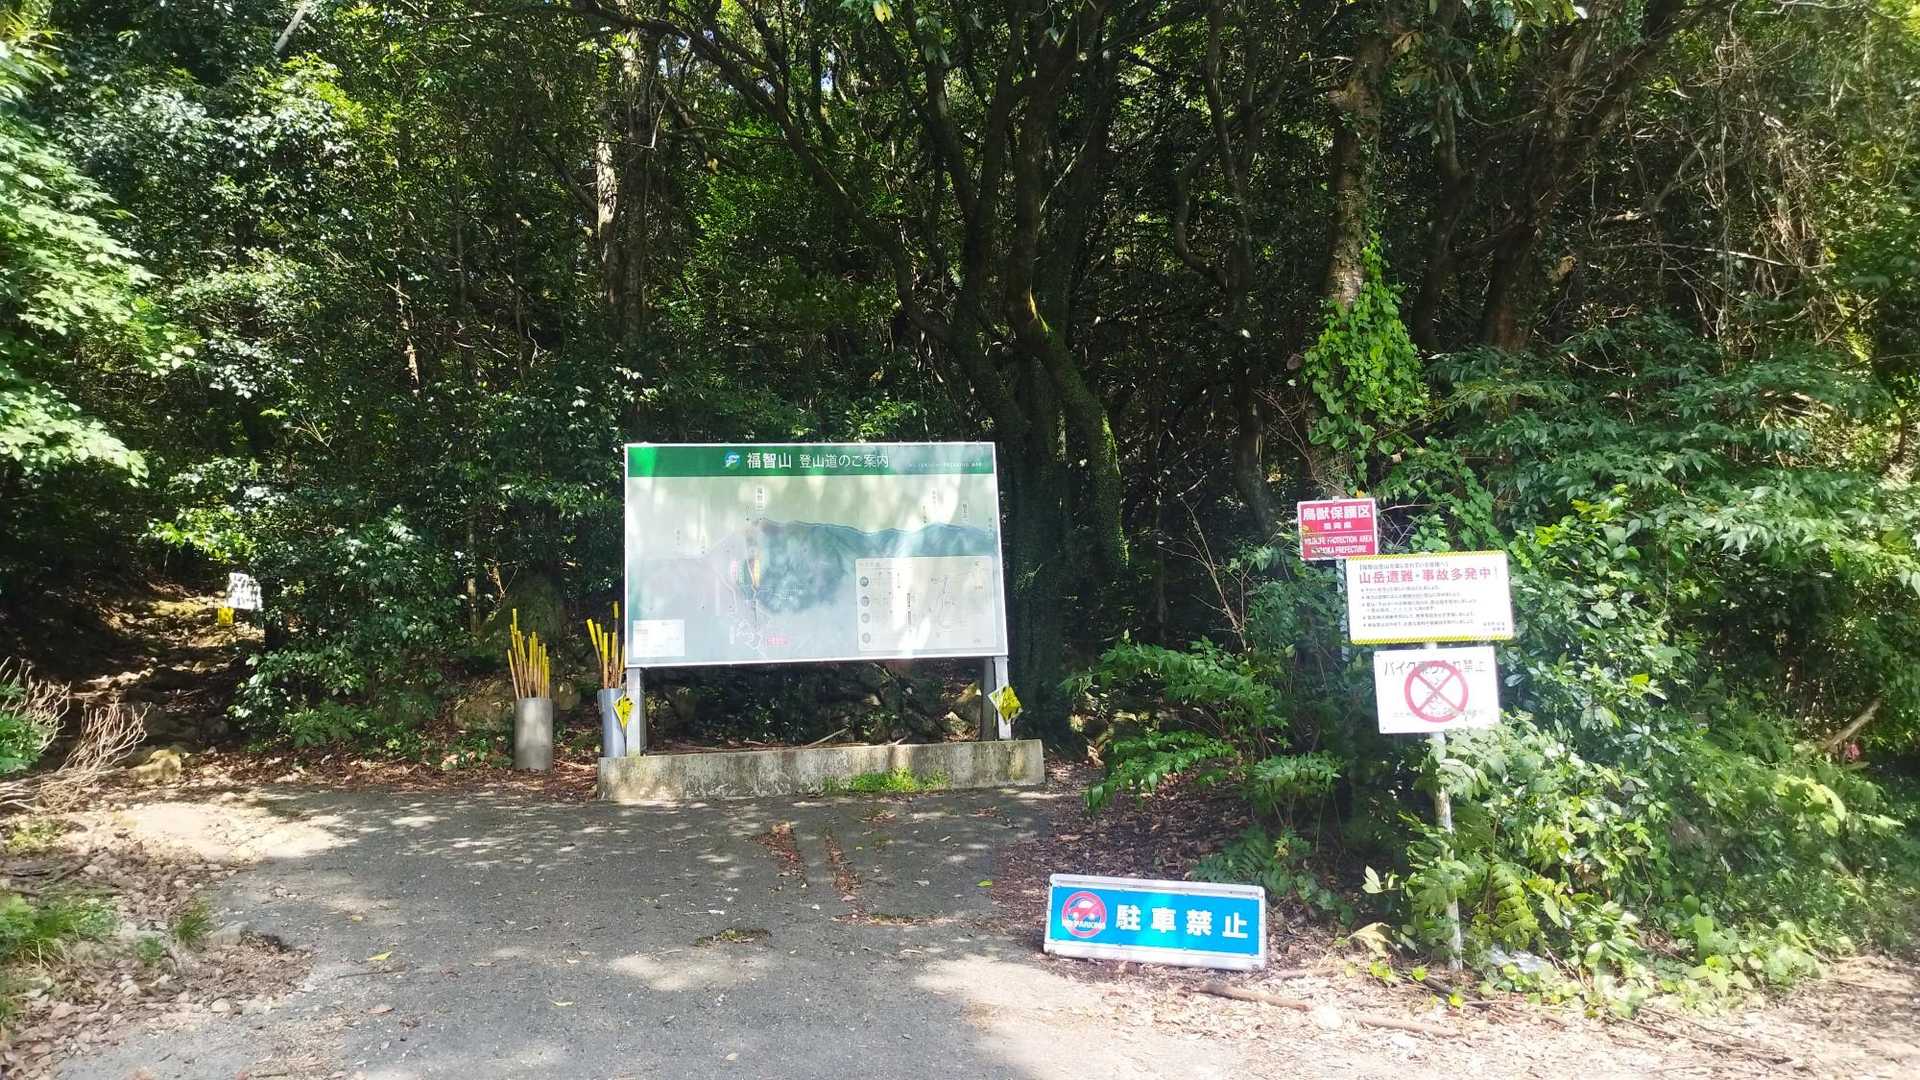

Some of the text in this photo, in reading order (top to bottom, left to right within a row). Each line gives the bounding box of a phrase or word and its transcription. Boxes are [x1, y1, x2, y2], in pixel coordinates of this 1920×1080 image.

[747, 451, 792, 469] 福智山
[799, 453, 890, 469] 登山道のご案内
[1303, 505, 1371, 520] 鳥獣保護区
[1115, 904, 1249, 939] 駐車禁止
